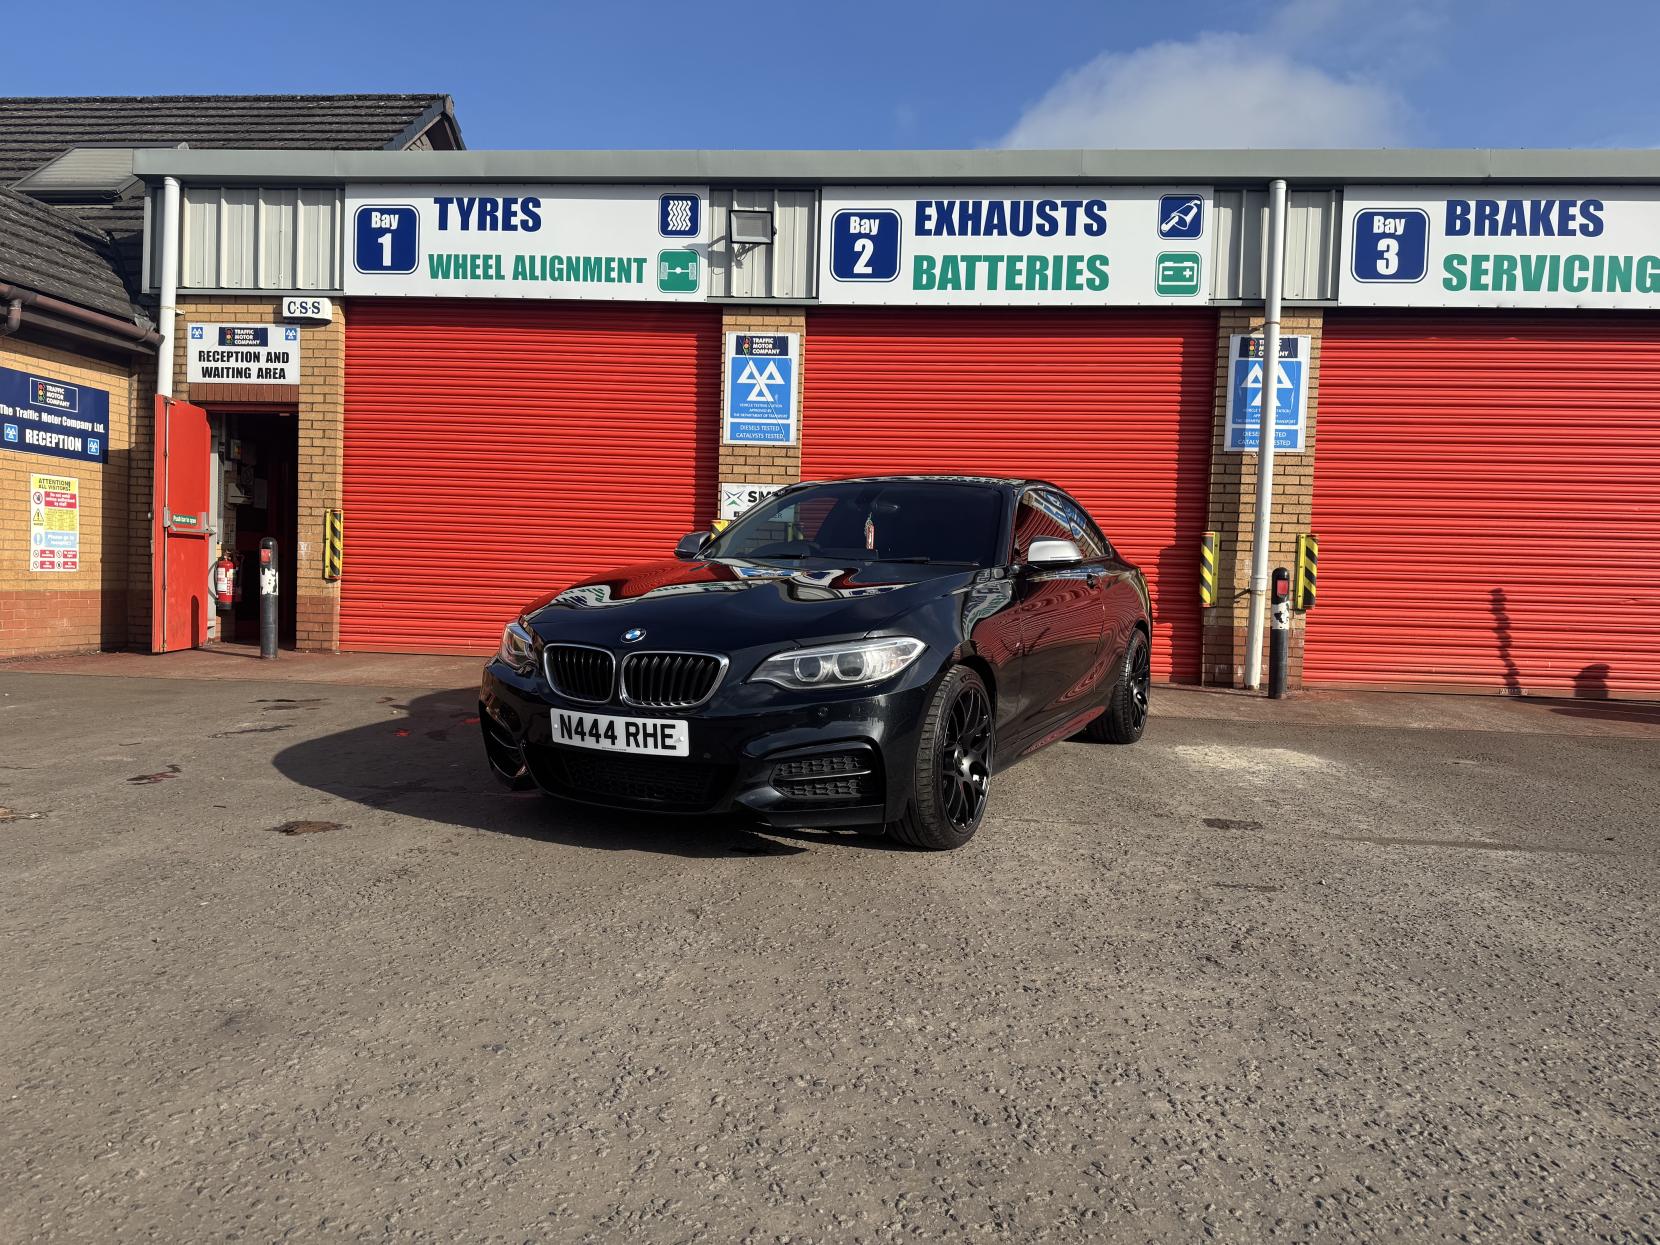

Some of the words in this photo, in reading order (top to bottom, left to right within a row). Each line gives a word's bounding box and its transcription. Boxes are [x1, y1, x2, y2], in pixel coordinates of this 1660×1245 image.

[371, 212, 399, 230] Bay
[433, 197, 543, 232] TYRES
[849, 216, 879, 236] Bay
[914, 199, 1107, 237] EXHAUSTS
[1373, 215, 1406, 236] Bay
[1444, 199, 1605, 238] BRAKES
[377, 233, 392, 267] 1
[853, 238, 874, 274] 2
[1376, 238, 1399, 276] 3
[428, 253, 506, 281] WHEEL
[512, 254, 648, 284] ALIGNMENT
[912, 254, 1110, 292] BATTERIES
[1442, 253, 1660, 294] SERVICING
[198, 350, 261, 364] RECEPTION
[266, 351, 290, 364] AND
[201, 366, 252, 379] WAITING
[256, 367, 286, 380] AREA
[0, 404, 13, 416] The
[16, 407, 39, 421] Traffic
[41, 412, 62, 426] Motor
[62, 416, 93, 431] Company
[25, 428, 82, 452] RECEPTION
[559, 713, 618, 746] N444
[624, 721, 677, 751] RHE
